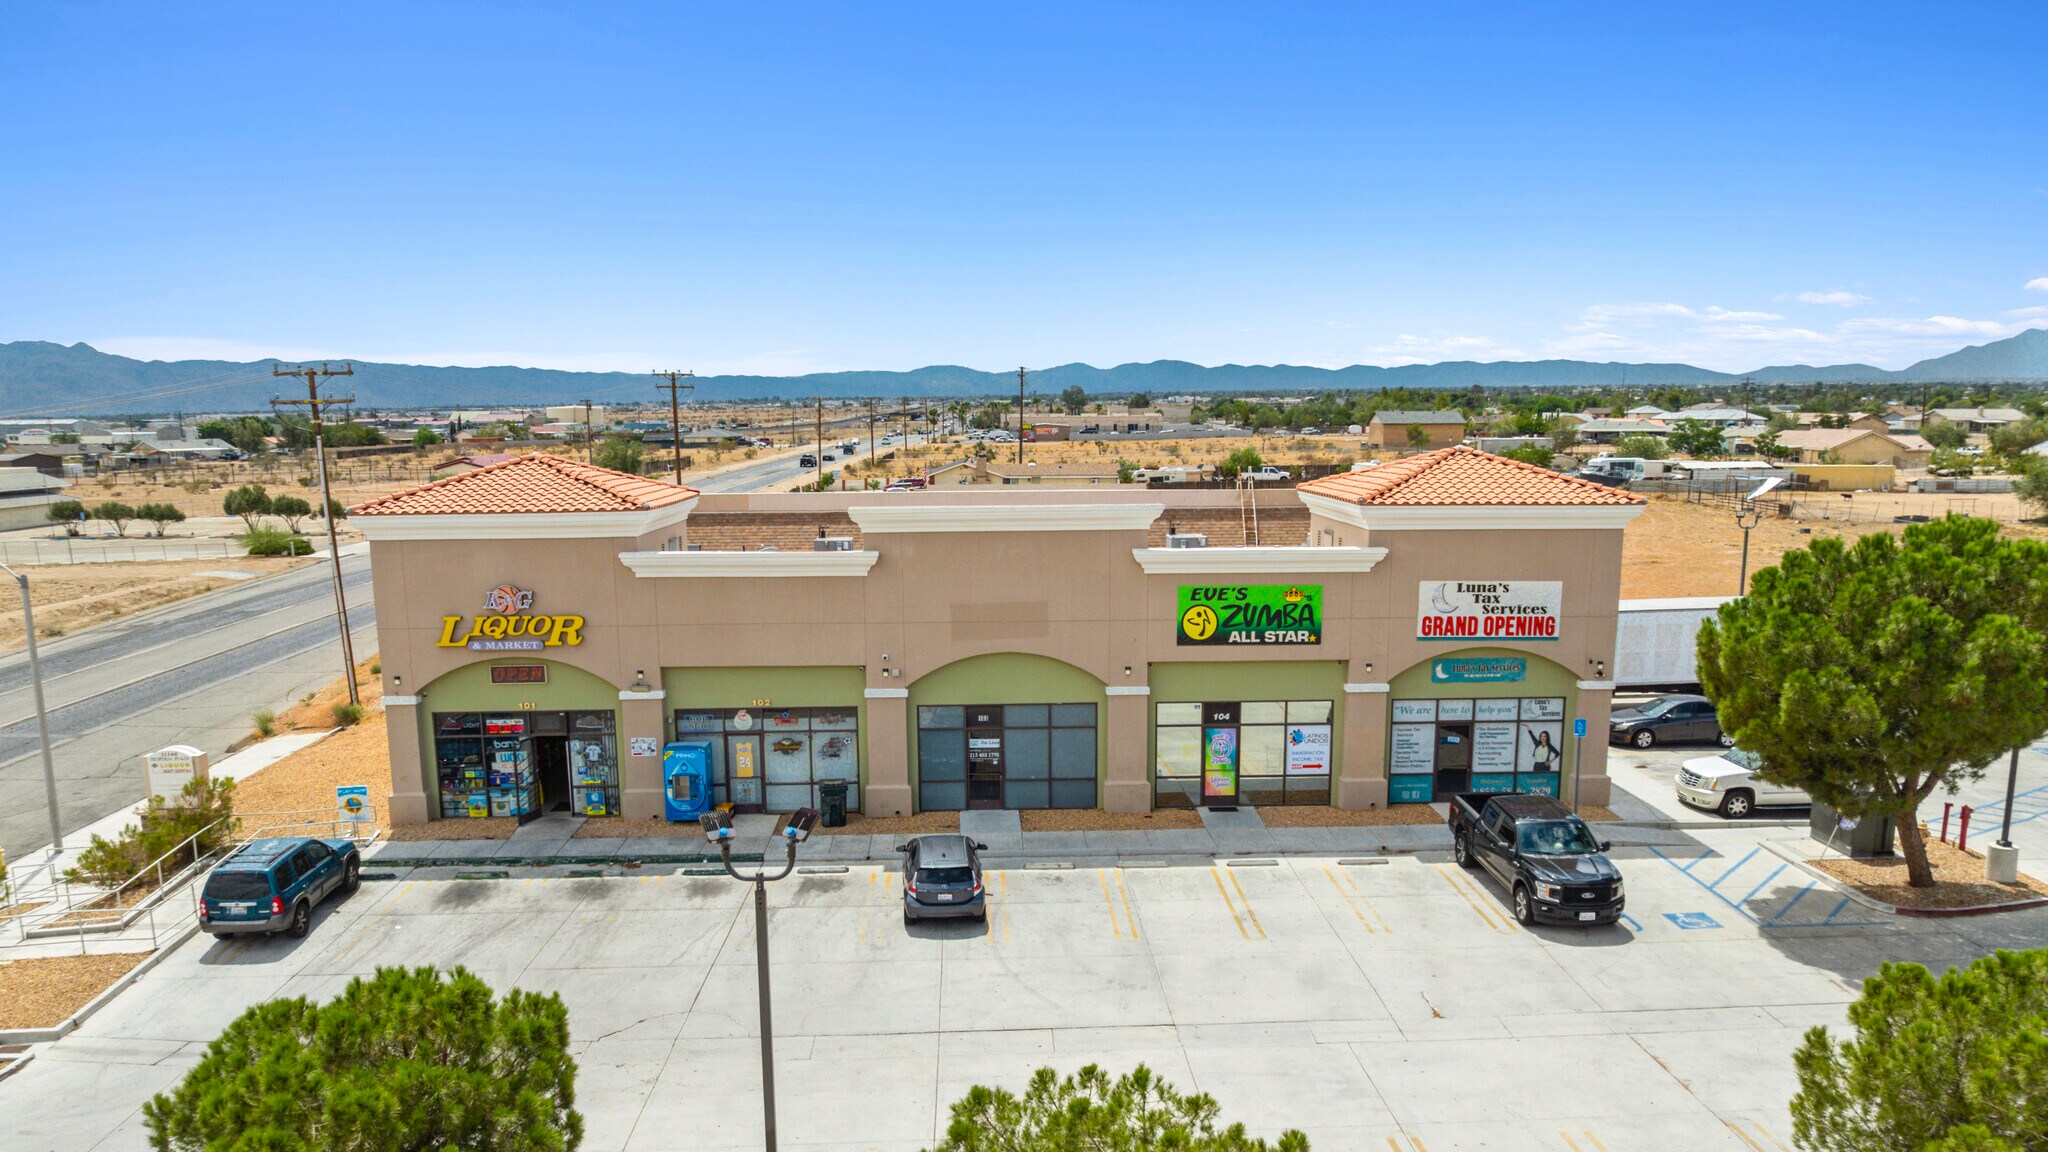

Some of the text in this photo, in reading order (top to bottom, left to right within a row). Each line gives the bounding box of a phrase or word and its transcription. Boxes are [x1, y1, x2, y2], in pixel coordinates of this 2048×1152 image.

[1456, 582, 1510, 592] Luna's
[483, 590, 533, 609] K&G
[1190, 588, 1248, 601] EVE'S
[1472, 594, 1500, 604] Tax
[1482, 604, 1548, 614] Services
[1220, 602, 1315, 629] ZUMBA
[436, 615, 585, 646] LIQUOR
[1422, 616, 1556, 636] GRAND OPENING
[1228, 630, 1309, 643] ALL STAR
[486, 642, 538, 650] MARKET
[1452, 664, 1520, 672] Luna's Tax Services
[493, 667, 543, 681] OPEN
[1478, 706, 1495, 714] help
[740, 757, 750, 768] 24
[1530, 787, 1551, 796] 2829
